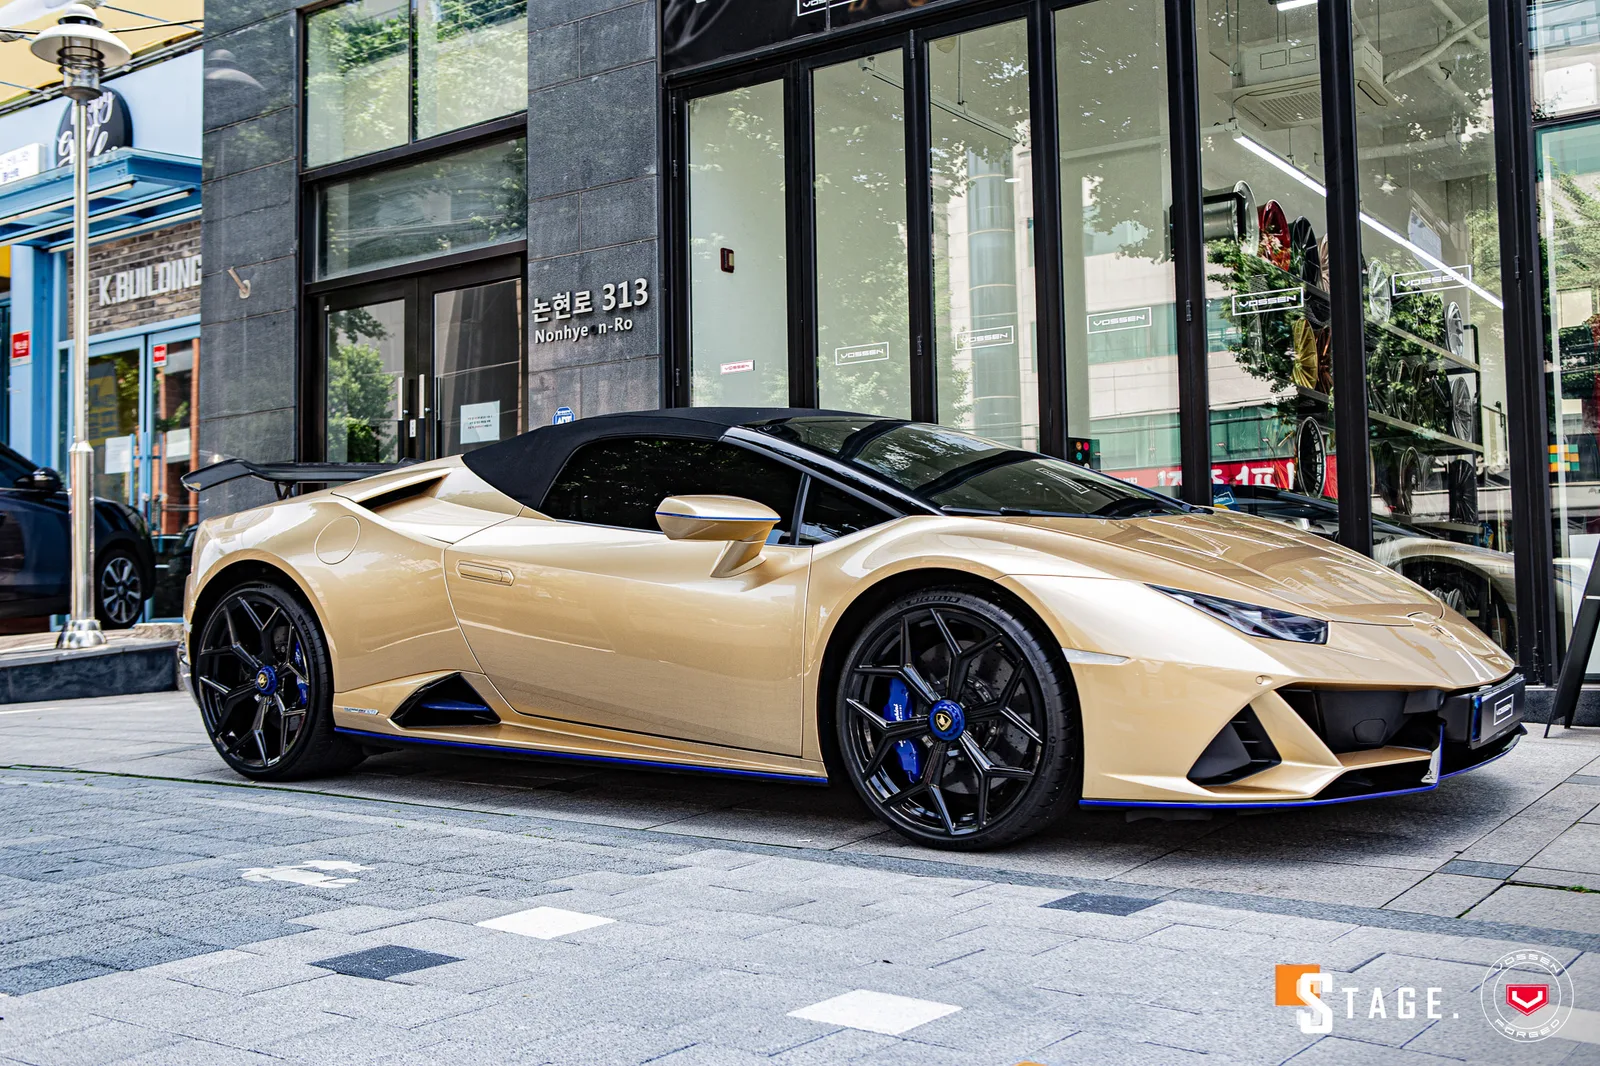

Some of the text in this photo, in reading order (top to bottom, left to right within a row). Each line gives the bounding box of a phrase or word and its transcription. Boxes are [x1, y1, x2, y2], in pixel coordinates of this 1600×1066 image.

[99, 254, 202, 306] K.BUILDING
[532, 278, 648, 323] 논현로 313
[1239, 295, 1297, 308] VOSSEN
[1092, 314, 1145, 326] VOSSEN
[535, 317, 633, 344] Nonhyen-Ro
[960, 332, 1008, 343] VOSSEN
[840, 348, 884, 359] VOSSEN
